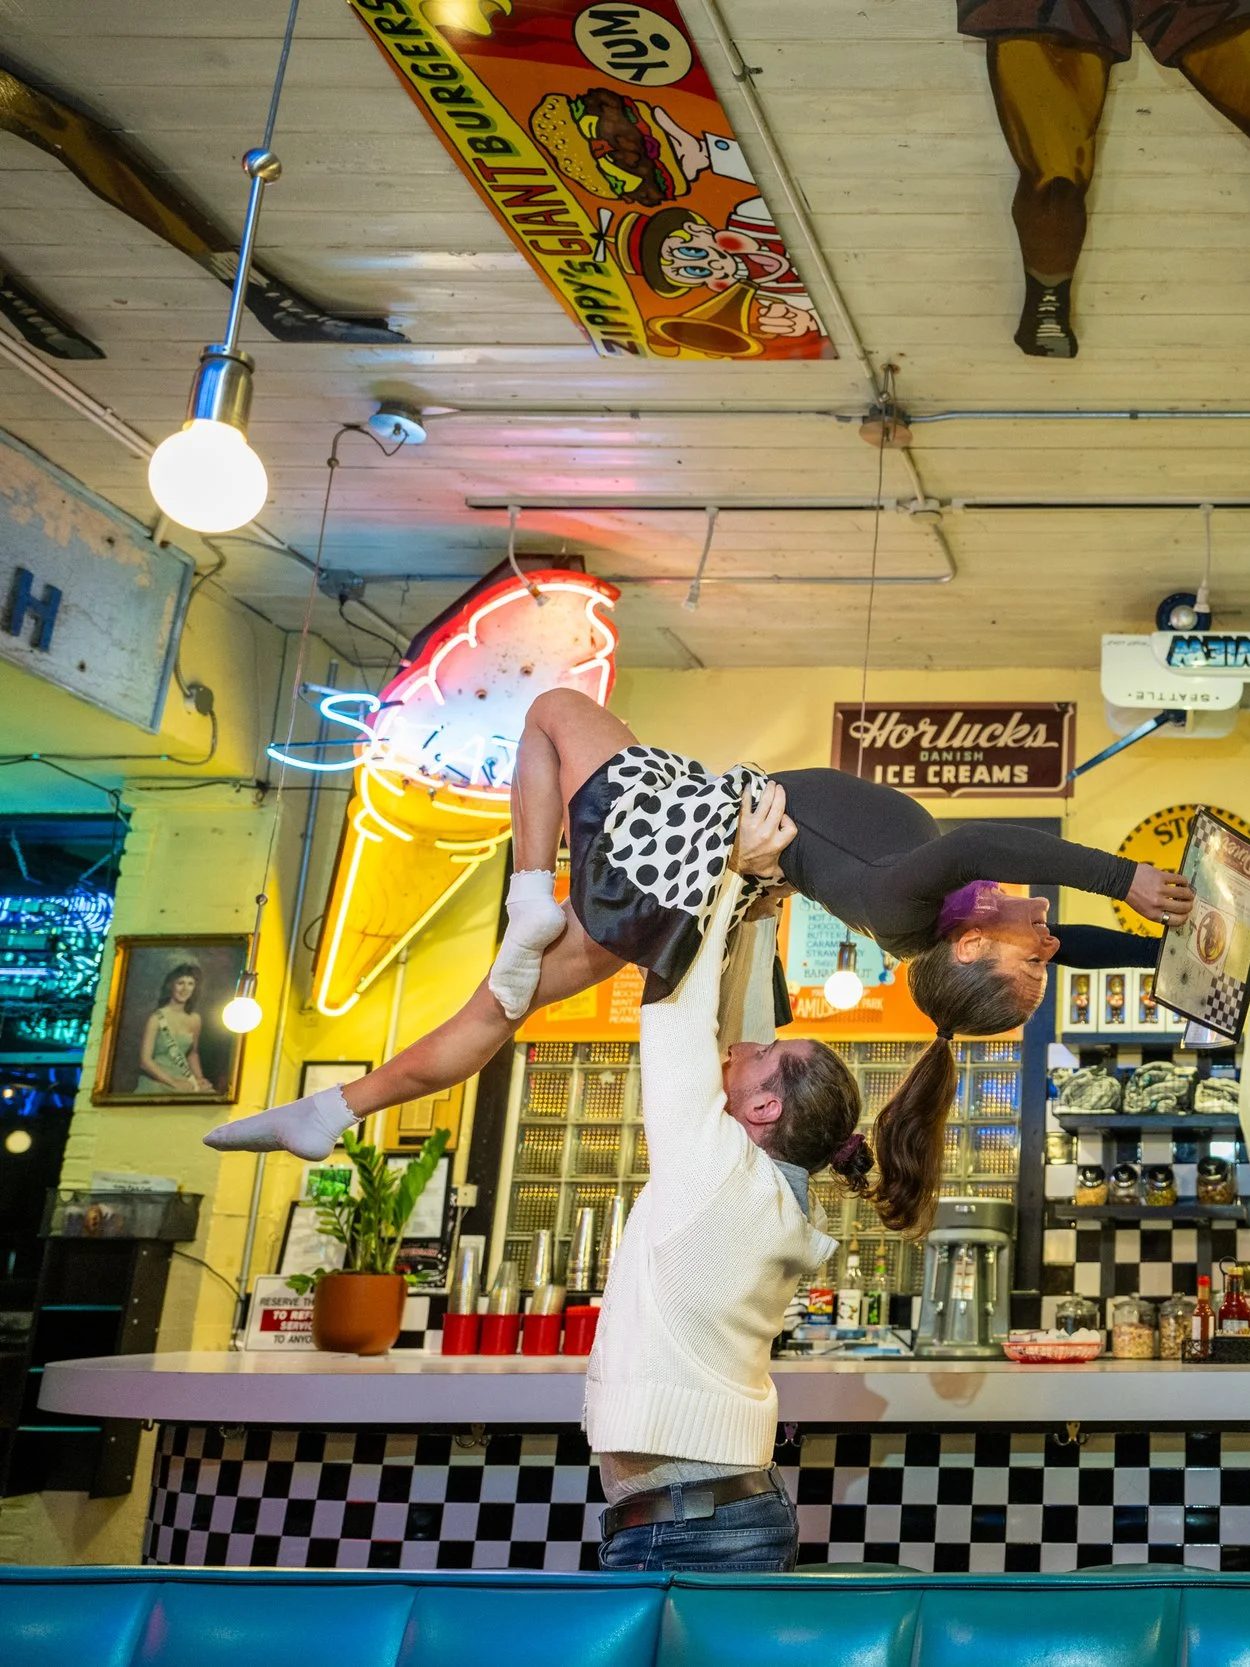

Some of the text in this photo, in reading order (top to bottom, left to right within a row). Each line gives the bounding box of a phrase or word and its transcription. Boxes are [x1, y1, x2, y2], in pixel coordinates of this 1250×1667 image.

[588, 9, 668, 82] YUM
[472, 157, 591, 257] GIANT
[1136, 691, 1211, 703] SEATTLE
[849, 711, 1059, 749] Horlucks
[919, 750, 984, 762] DANISH
[873, 764, 1030, 784] ICE CREAMS
[259, 1297, 300, 1306] RESERVE
[273, 1310, 314, 1320] TO REF
[280, 1321, 314, 1331] SERVIC
[274, 1334, 314, 1344] TO ANYO
